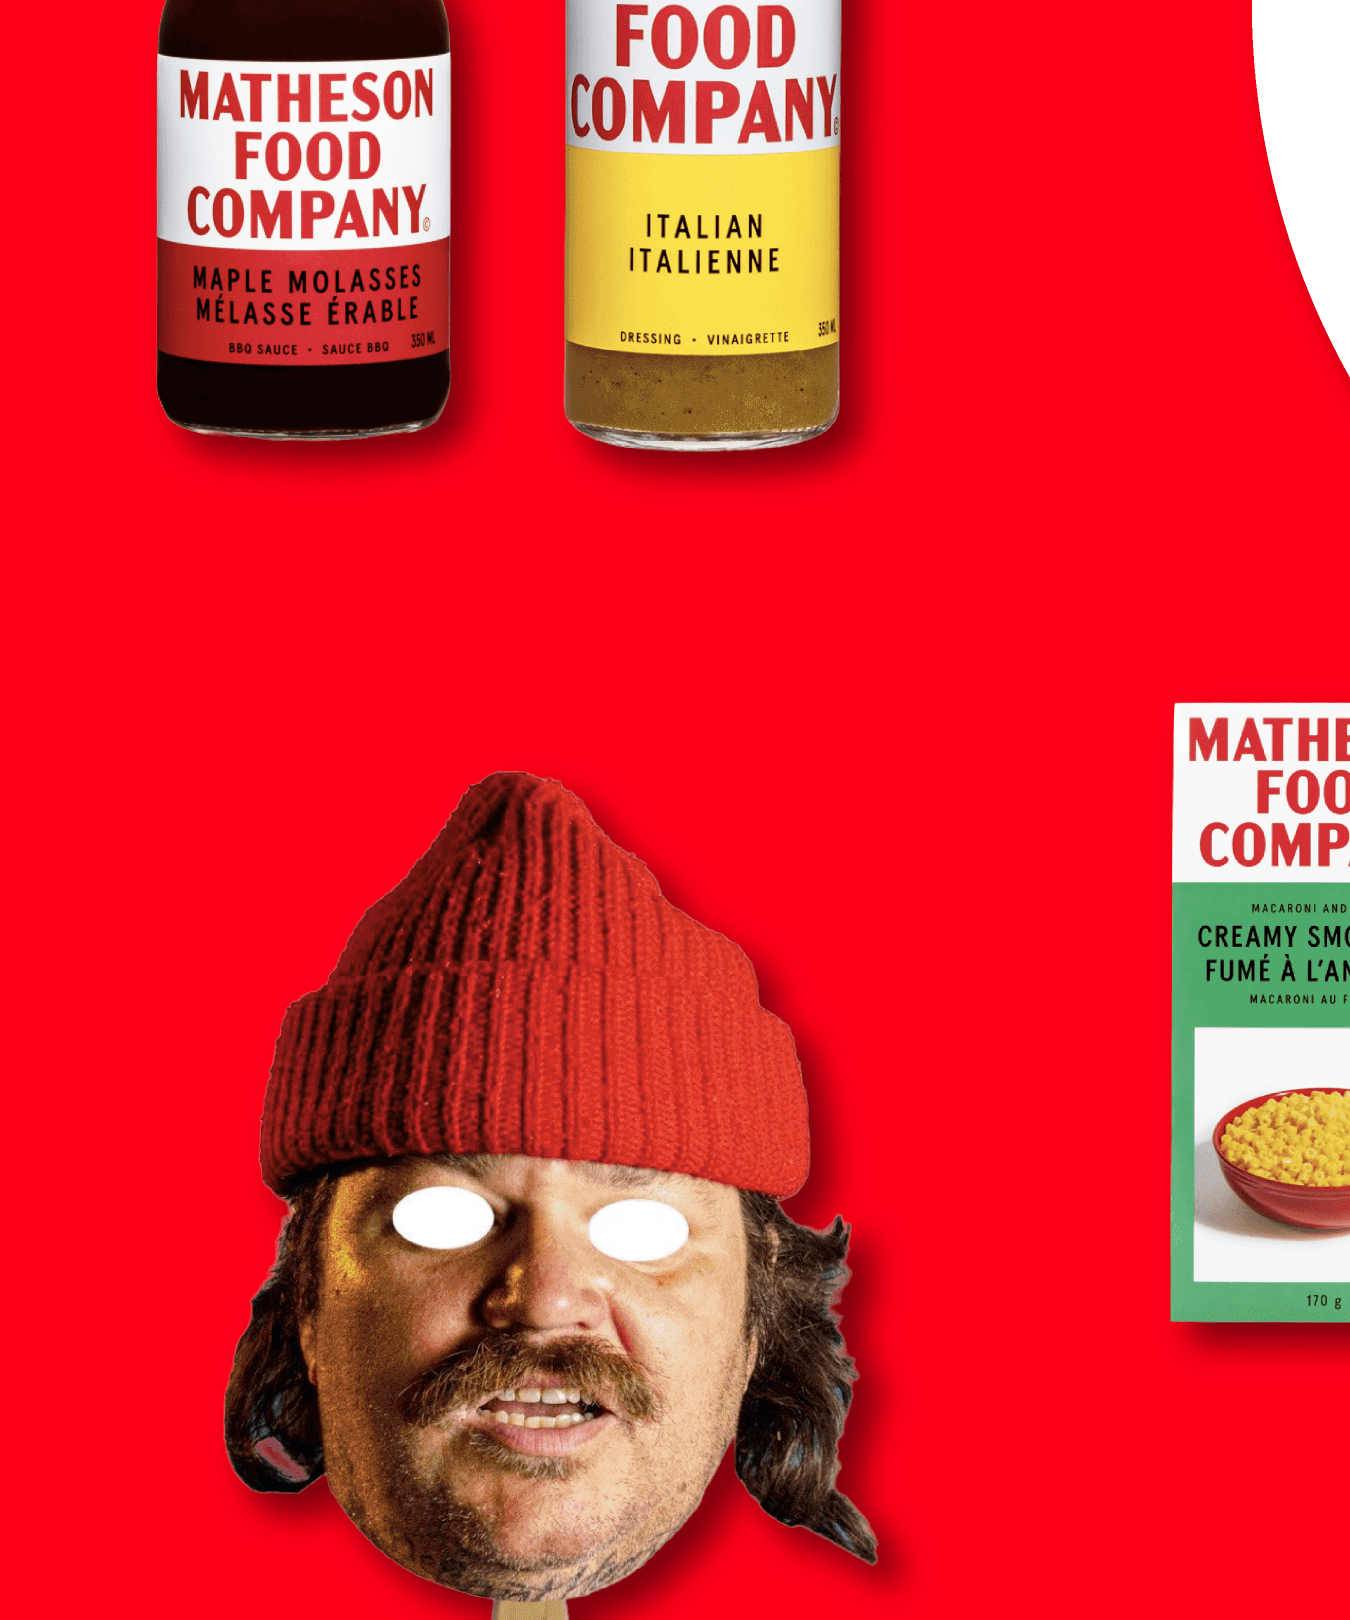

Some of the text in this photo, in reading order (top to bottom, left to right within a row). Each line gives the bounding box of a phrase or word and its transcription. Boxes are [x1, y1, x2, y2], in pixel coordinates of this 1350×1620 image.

[616, 4, 796, 70] FOOD
[180, 68, 434, 123] MATHESON
[235, 131, 381, 182] FOOD
[646, 213, 762, 239] ITALIAN
[629, 247, 780, 274] ITALIENNE
[193, 264, 422, 294] MAPLE MOLASSES
[196, 293, 418, 326] MÉLASSE ÉRABLE
[229, 340, 390, 356] BBQ SAUCE SAUCE BBQ
[411, 333, 425, 349] 350
[620, 331, 790, 346] DRESSING VINAIGRETTE
[1251, 903, 1317, 914] MACARONI
[1322, 903, 1348, 914] AND
[1198, 924, 1298, 948] CREAMY
[1206, 953, 1270, 982] FUMÉ
[1280, 953, 1296, 982] À
[1250, 994, 1315, 1005] MACARONI
[1320, 994, 1337, 1005] AU
[1306, 1294, 1342, 1310] 170 g
